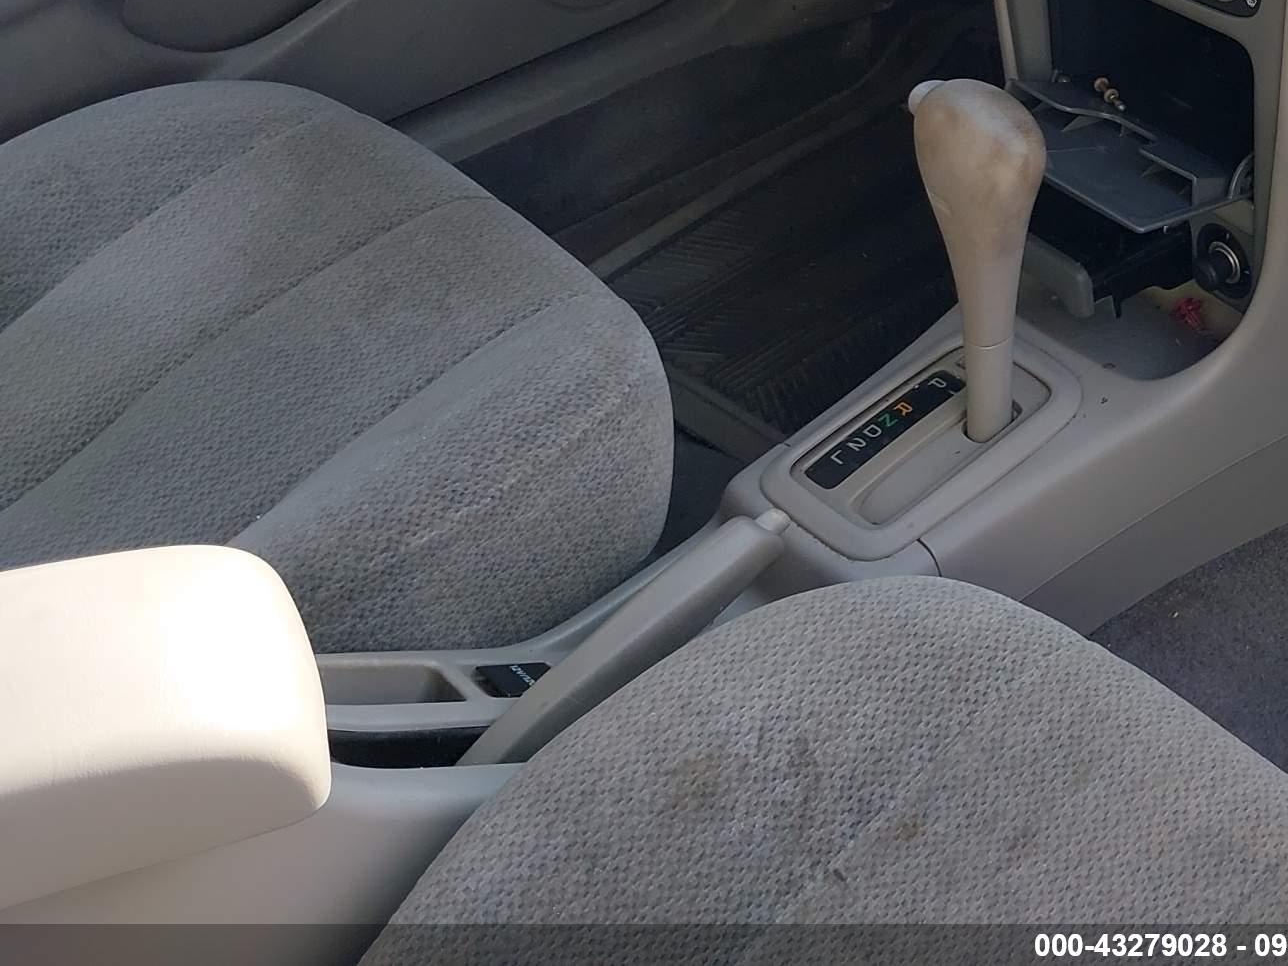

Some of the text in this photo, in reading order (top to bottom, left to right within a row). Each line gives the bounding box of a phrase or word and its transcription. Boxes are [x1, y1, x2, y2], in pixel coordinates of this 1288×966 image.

[927, 377, 947, 388] P
[894, 401, 913, 416] R
[863, 424, 882, 438] D
[830, 449, 844, 465] L
